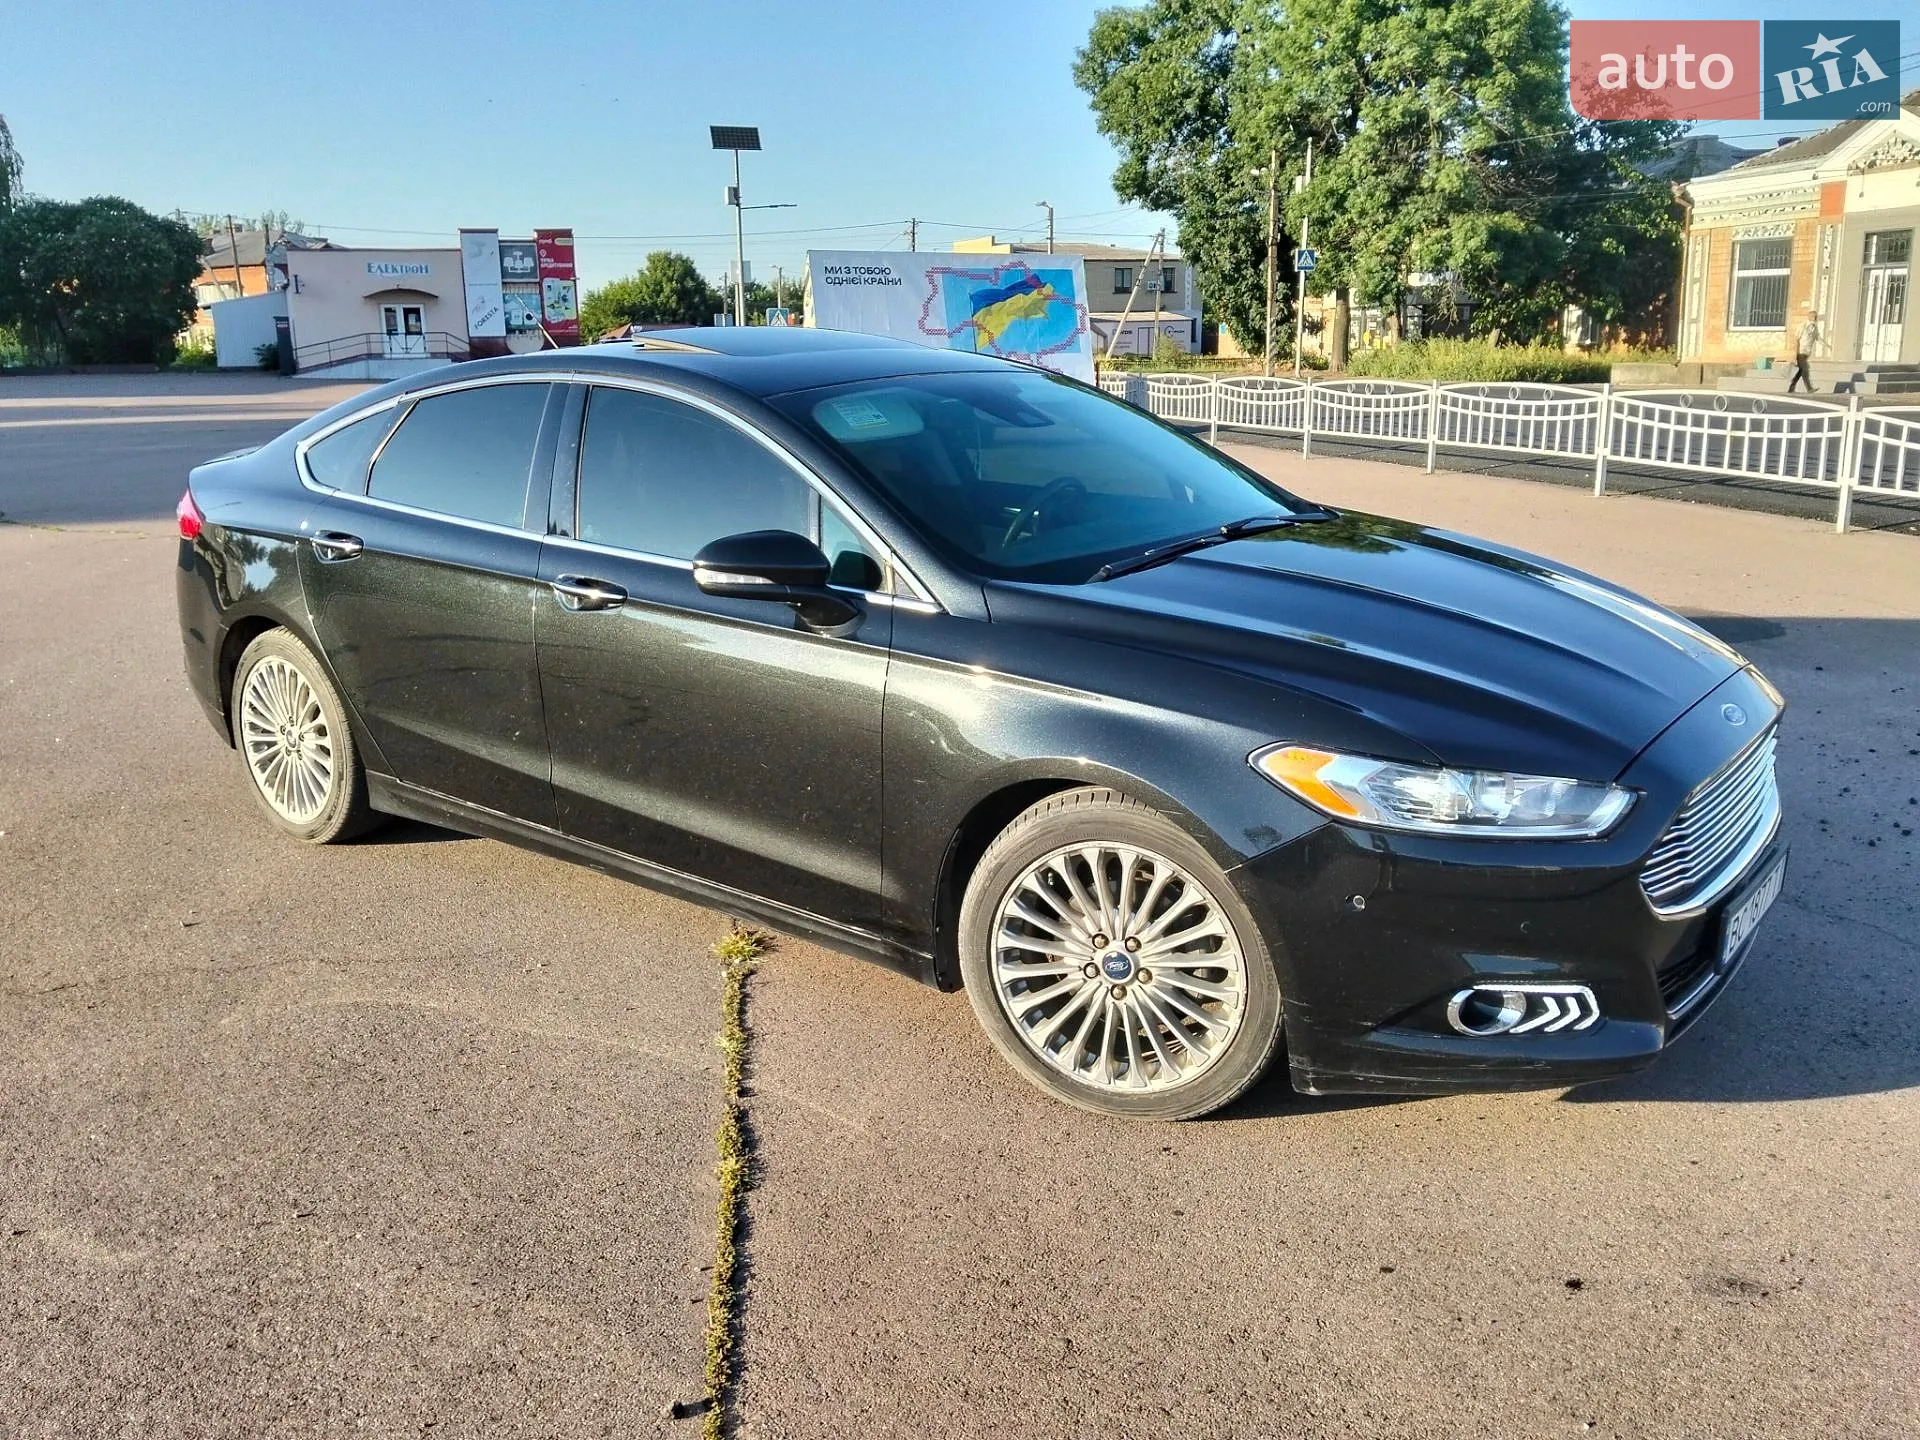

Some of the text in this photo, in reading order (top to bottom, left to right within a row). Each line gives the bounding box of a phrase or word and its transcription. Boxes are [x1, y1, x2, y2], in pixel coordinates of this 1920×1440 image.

[825, 266, 891, 275] МИ З ТОБОЮ
[825, 275, 902, 286] ОДНІЄЇ КРАЇНИ
